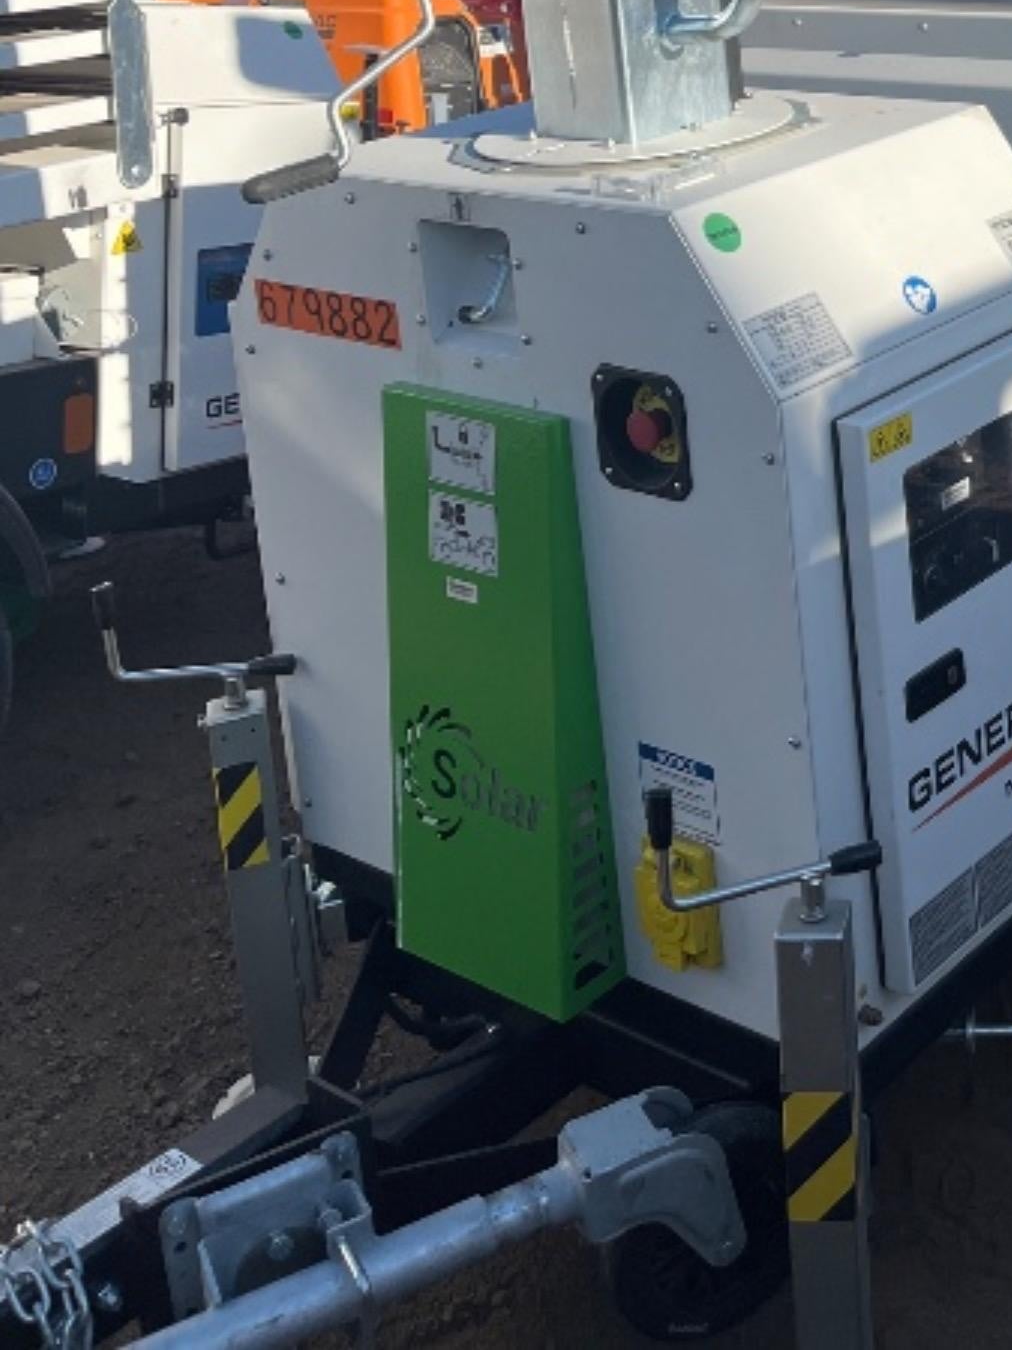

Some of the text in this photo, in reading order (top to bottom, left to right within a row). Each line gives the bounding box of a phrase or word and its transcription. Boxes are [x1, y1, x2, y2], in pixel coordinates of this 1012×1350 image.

[260, 281, 397, 345] 679882
[206, 392, 240, 418] GE
[432, 749, 546, 832] Solar
